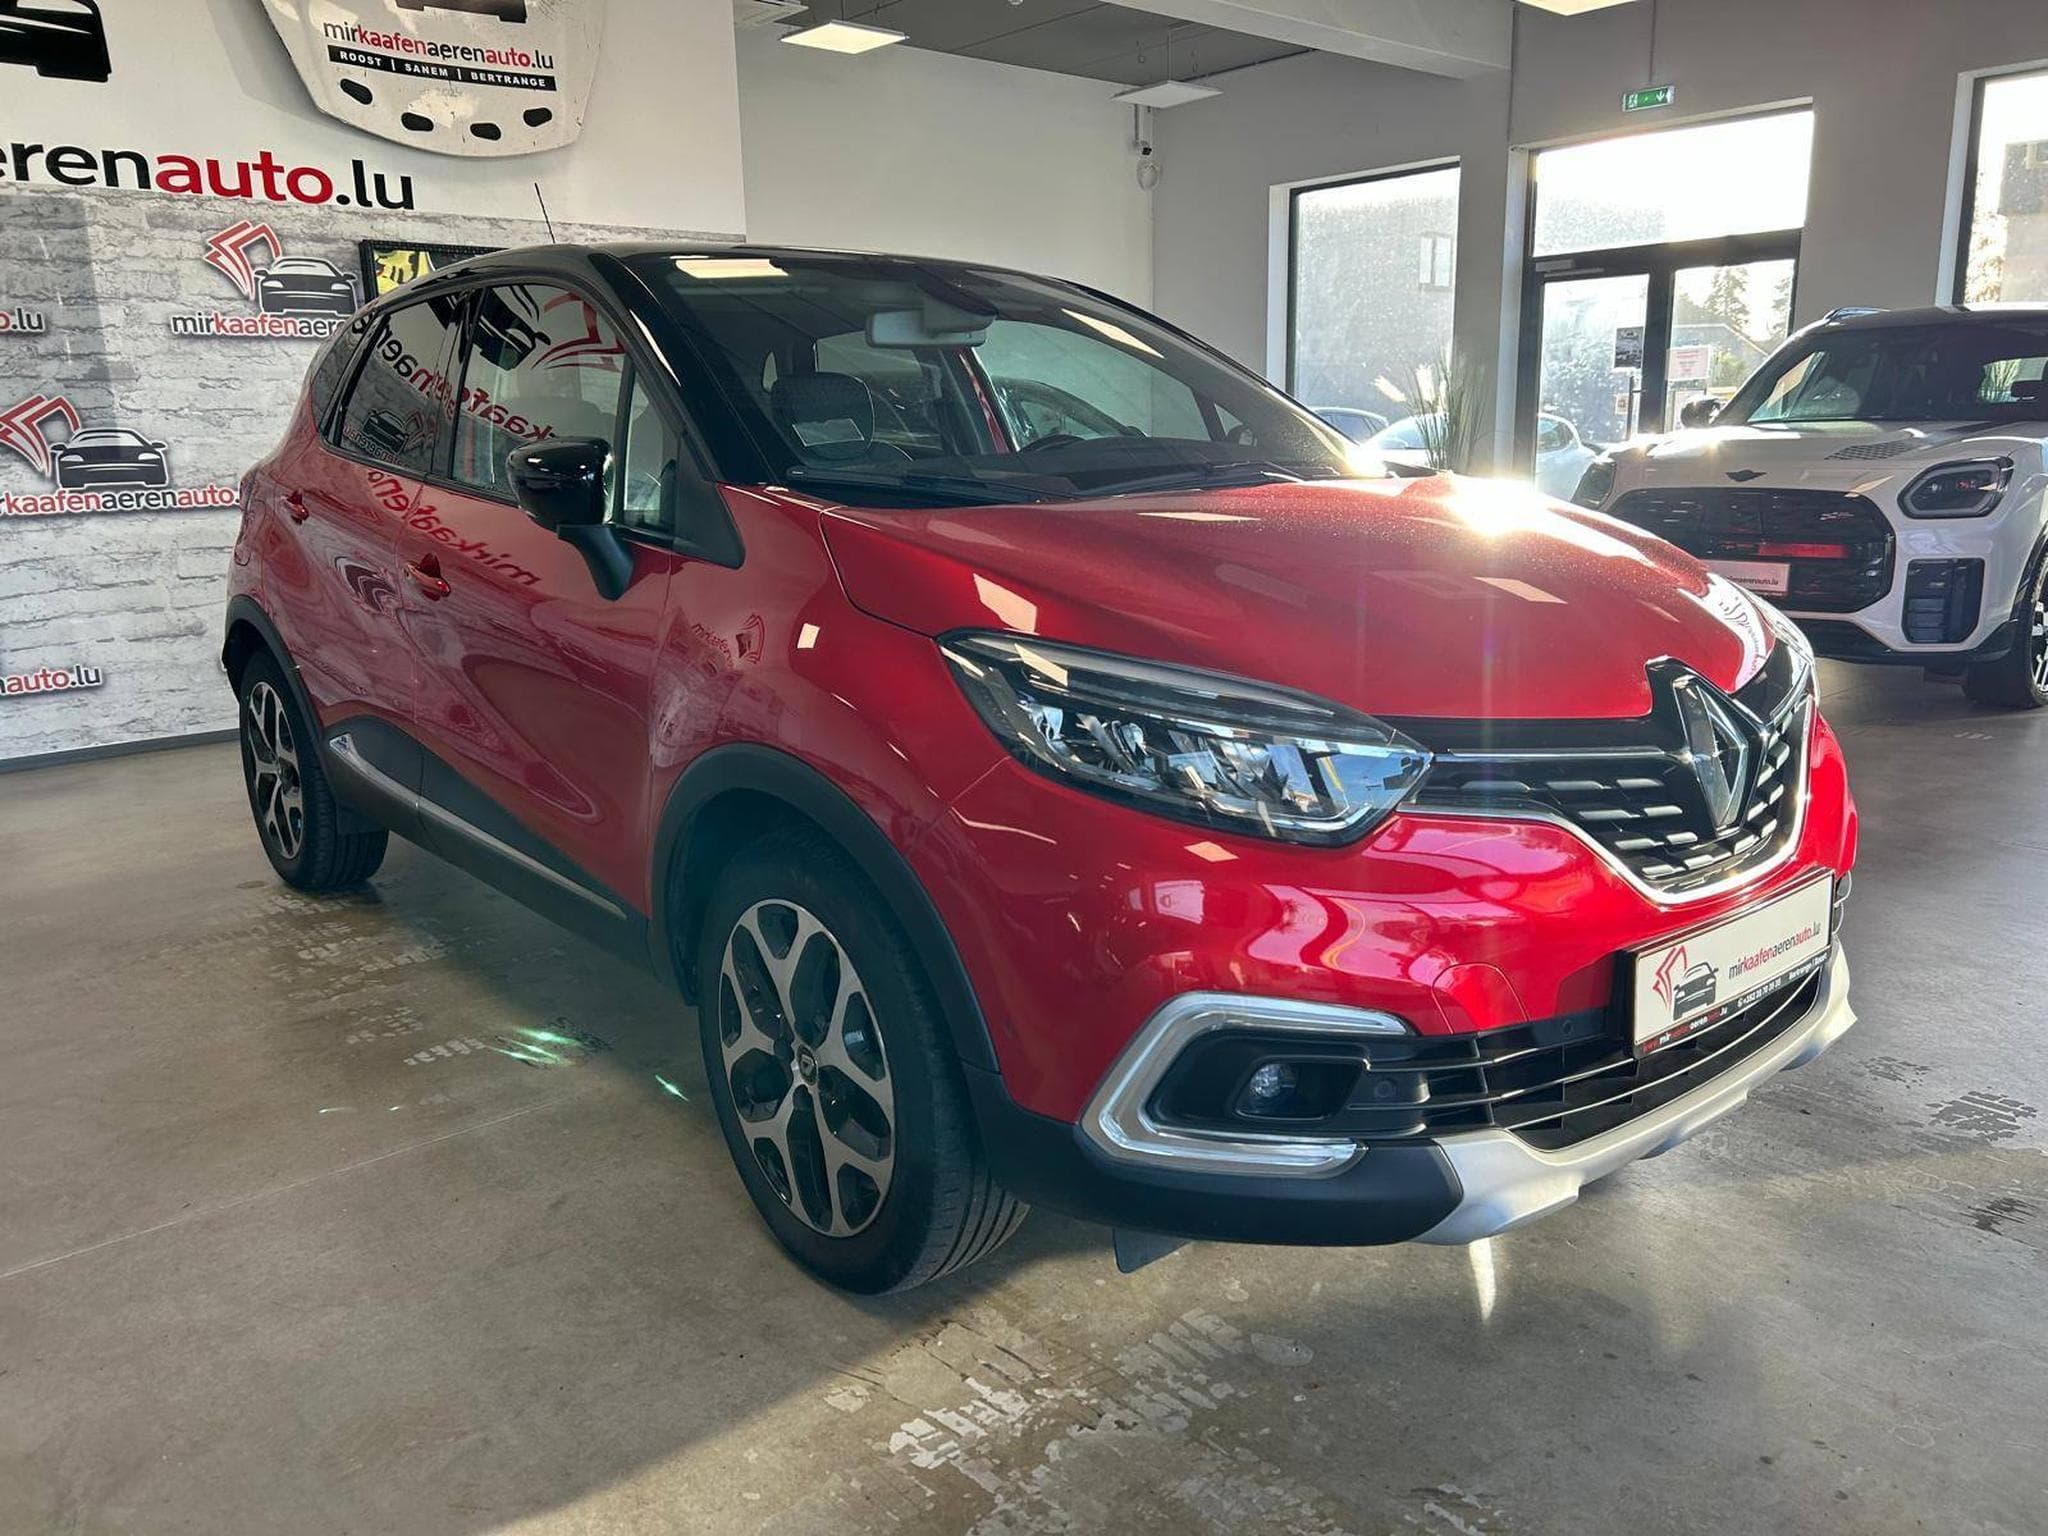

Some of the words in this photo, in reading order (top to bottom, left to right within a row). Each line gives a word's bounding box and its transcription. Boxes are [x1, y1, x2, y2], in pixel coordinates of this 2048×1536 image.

[323, 21, 554, 69] mirkaafenaerenauto.lu
[339, 50, 382, 67] ROOST
[404, 62, 449, 78] SANEM
[470, 71, 546, 88] BERTRANGE
[0, 142, 415, 210] renauto.lu
[0, 484, 240, 513] kaafenaerenauto.
[1728, 921, 1821, 979] mirkaafenaerenauto.lu
